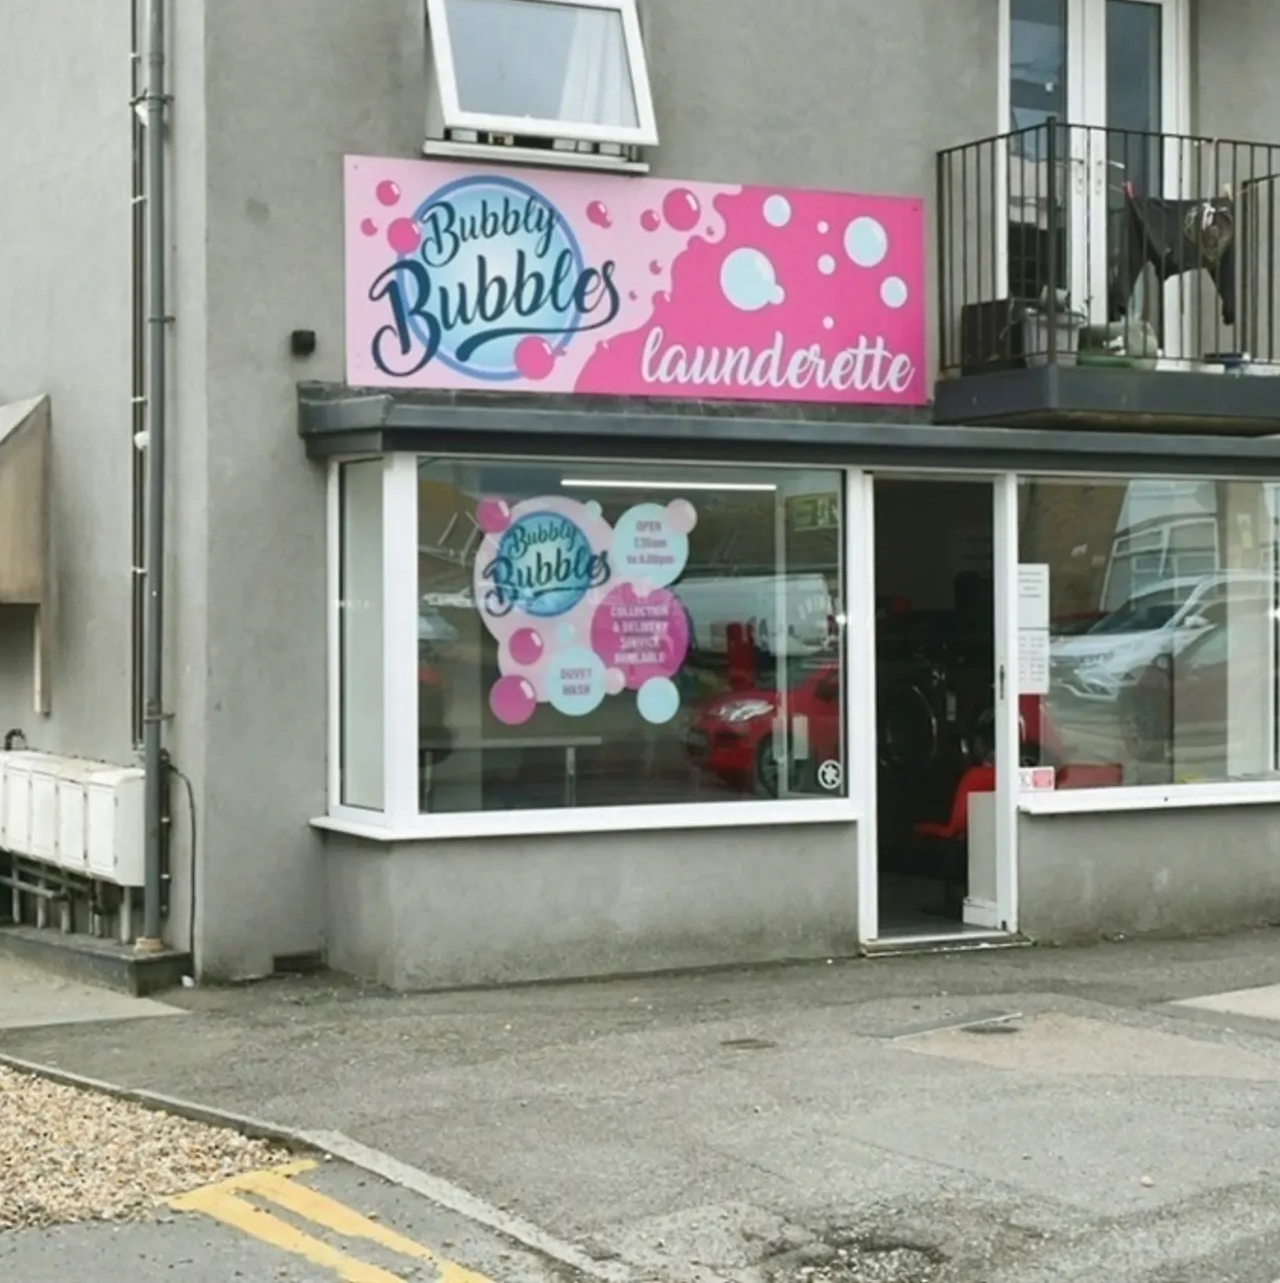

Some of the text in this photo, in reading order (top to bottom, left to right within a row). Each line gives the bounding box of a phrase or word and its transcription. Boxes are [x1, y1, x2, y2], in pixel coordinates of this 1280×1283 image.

[420, 194, 558, 268] Bubbly
[368, 248, 620, 377] Bubbles
[640, 326, 915, 393] launderette
[506, 519, 578, 559] Bubbly
[635, 520, 662, 532] OPEN
[482, 545, 612, 618] Bubbles
[559, 667, 592, 680] DUVET
[561, 683, 591, 696] WASH
